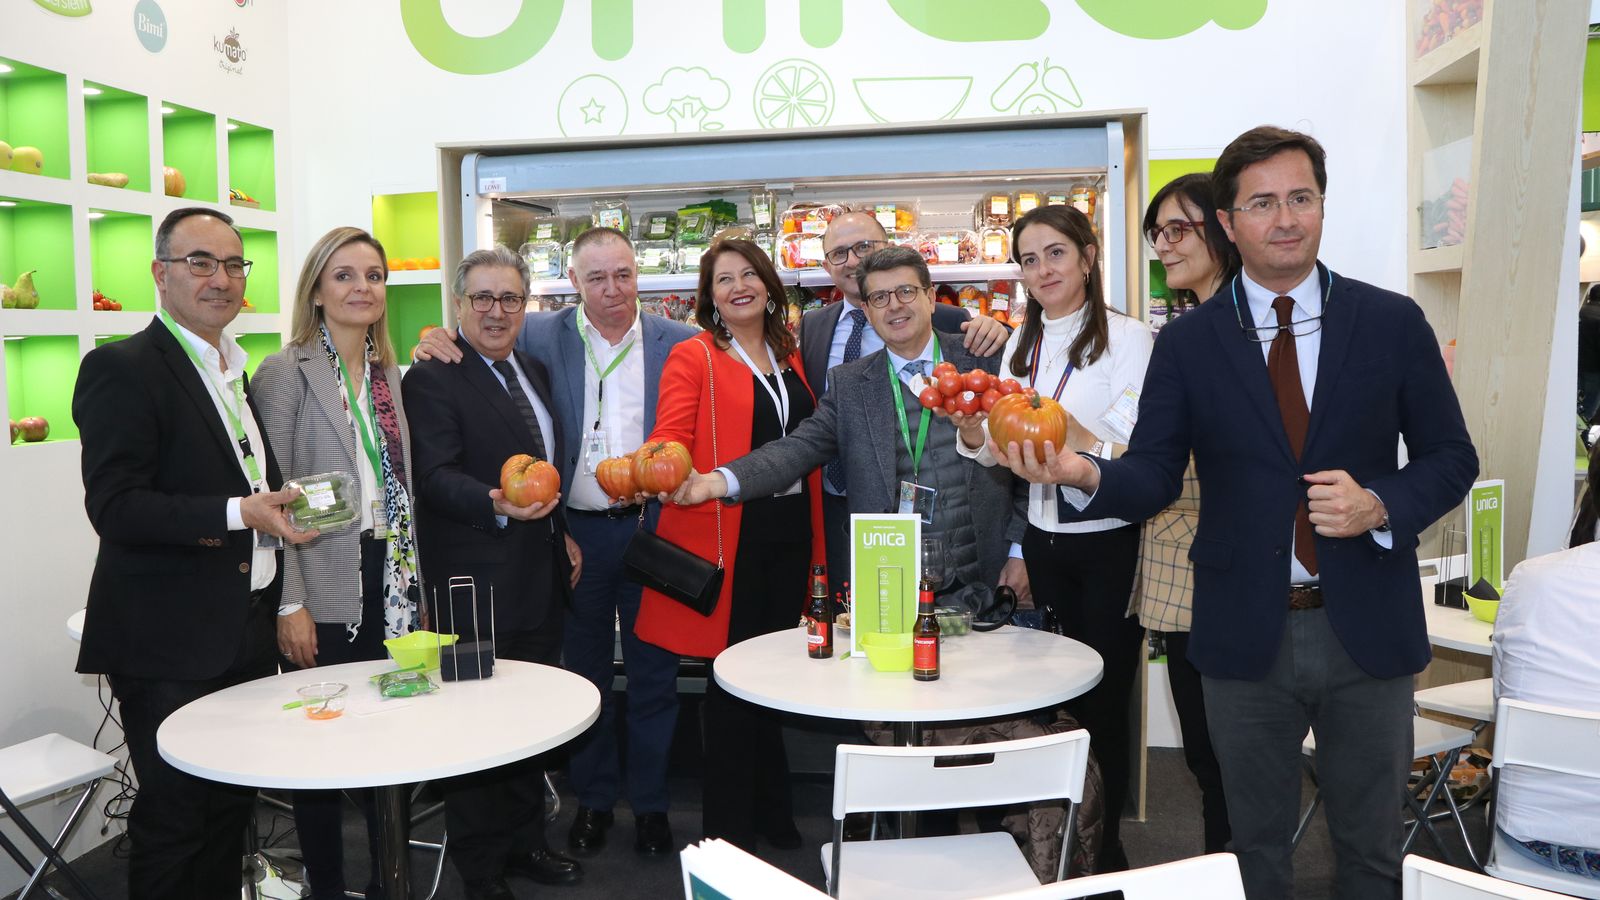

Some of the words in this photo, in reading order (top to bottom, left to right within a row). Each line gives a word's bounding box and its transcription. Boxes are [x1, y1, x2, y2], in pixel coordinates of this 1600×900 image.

[138, 13, 163, 38] Bimi
[213, 34, 247, 62] kumato
[863, 532, 906, 547] unica
